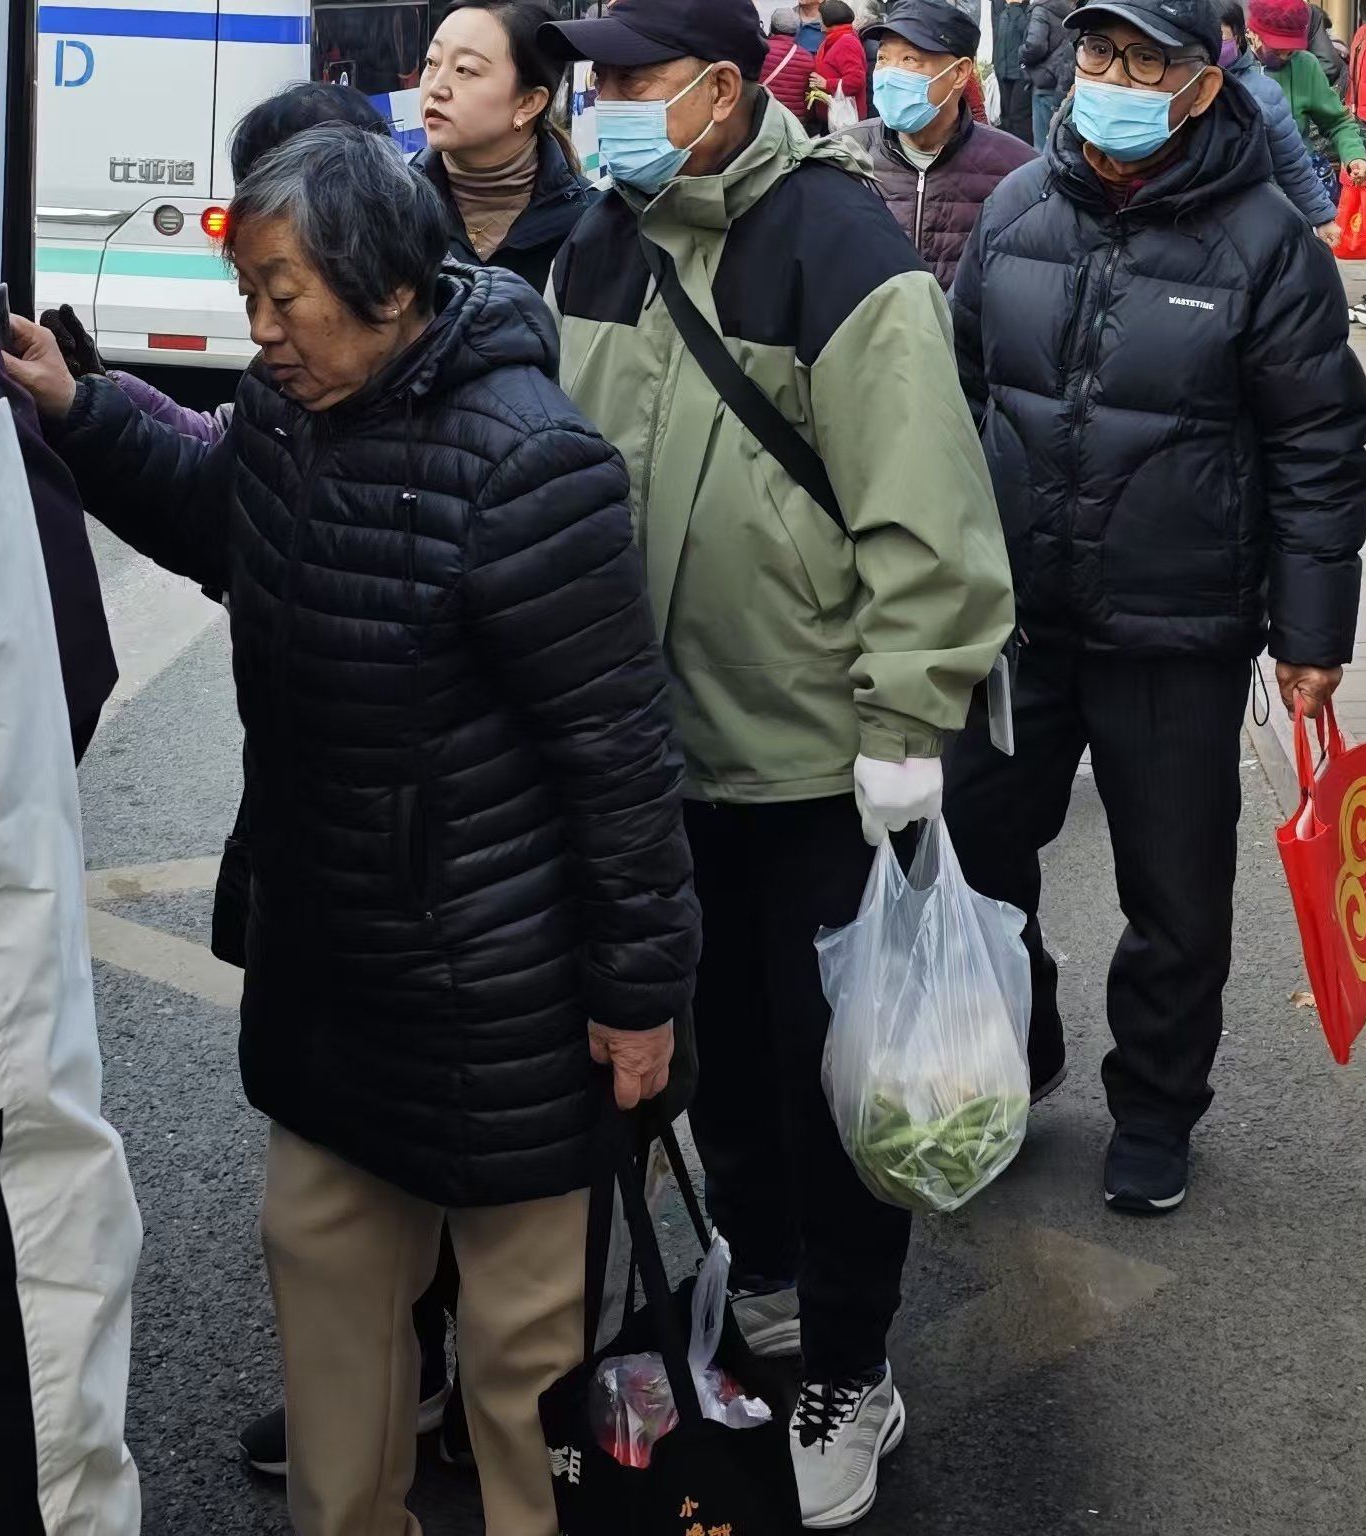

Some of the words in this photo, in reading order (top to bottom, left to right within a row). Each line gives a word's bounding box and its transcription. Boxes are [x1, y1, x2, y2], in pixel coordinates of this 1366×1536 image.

[54, 39, 95, 87] D
[108, 156, 195, 185] 比亚迪
